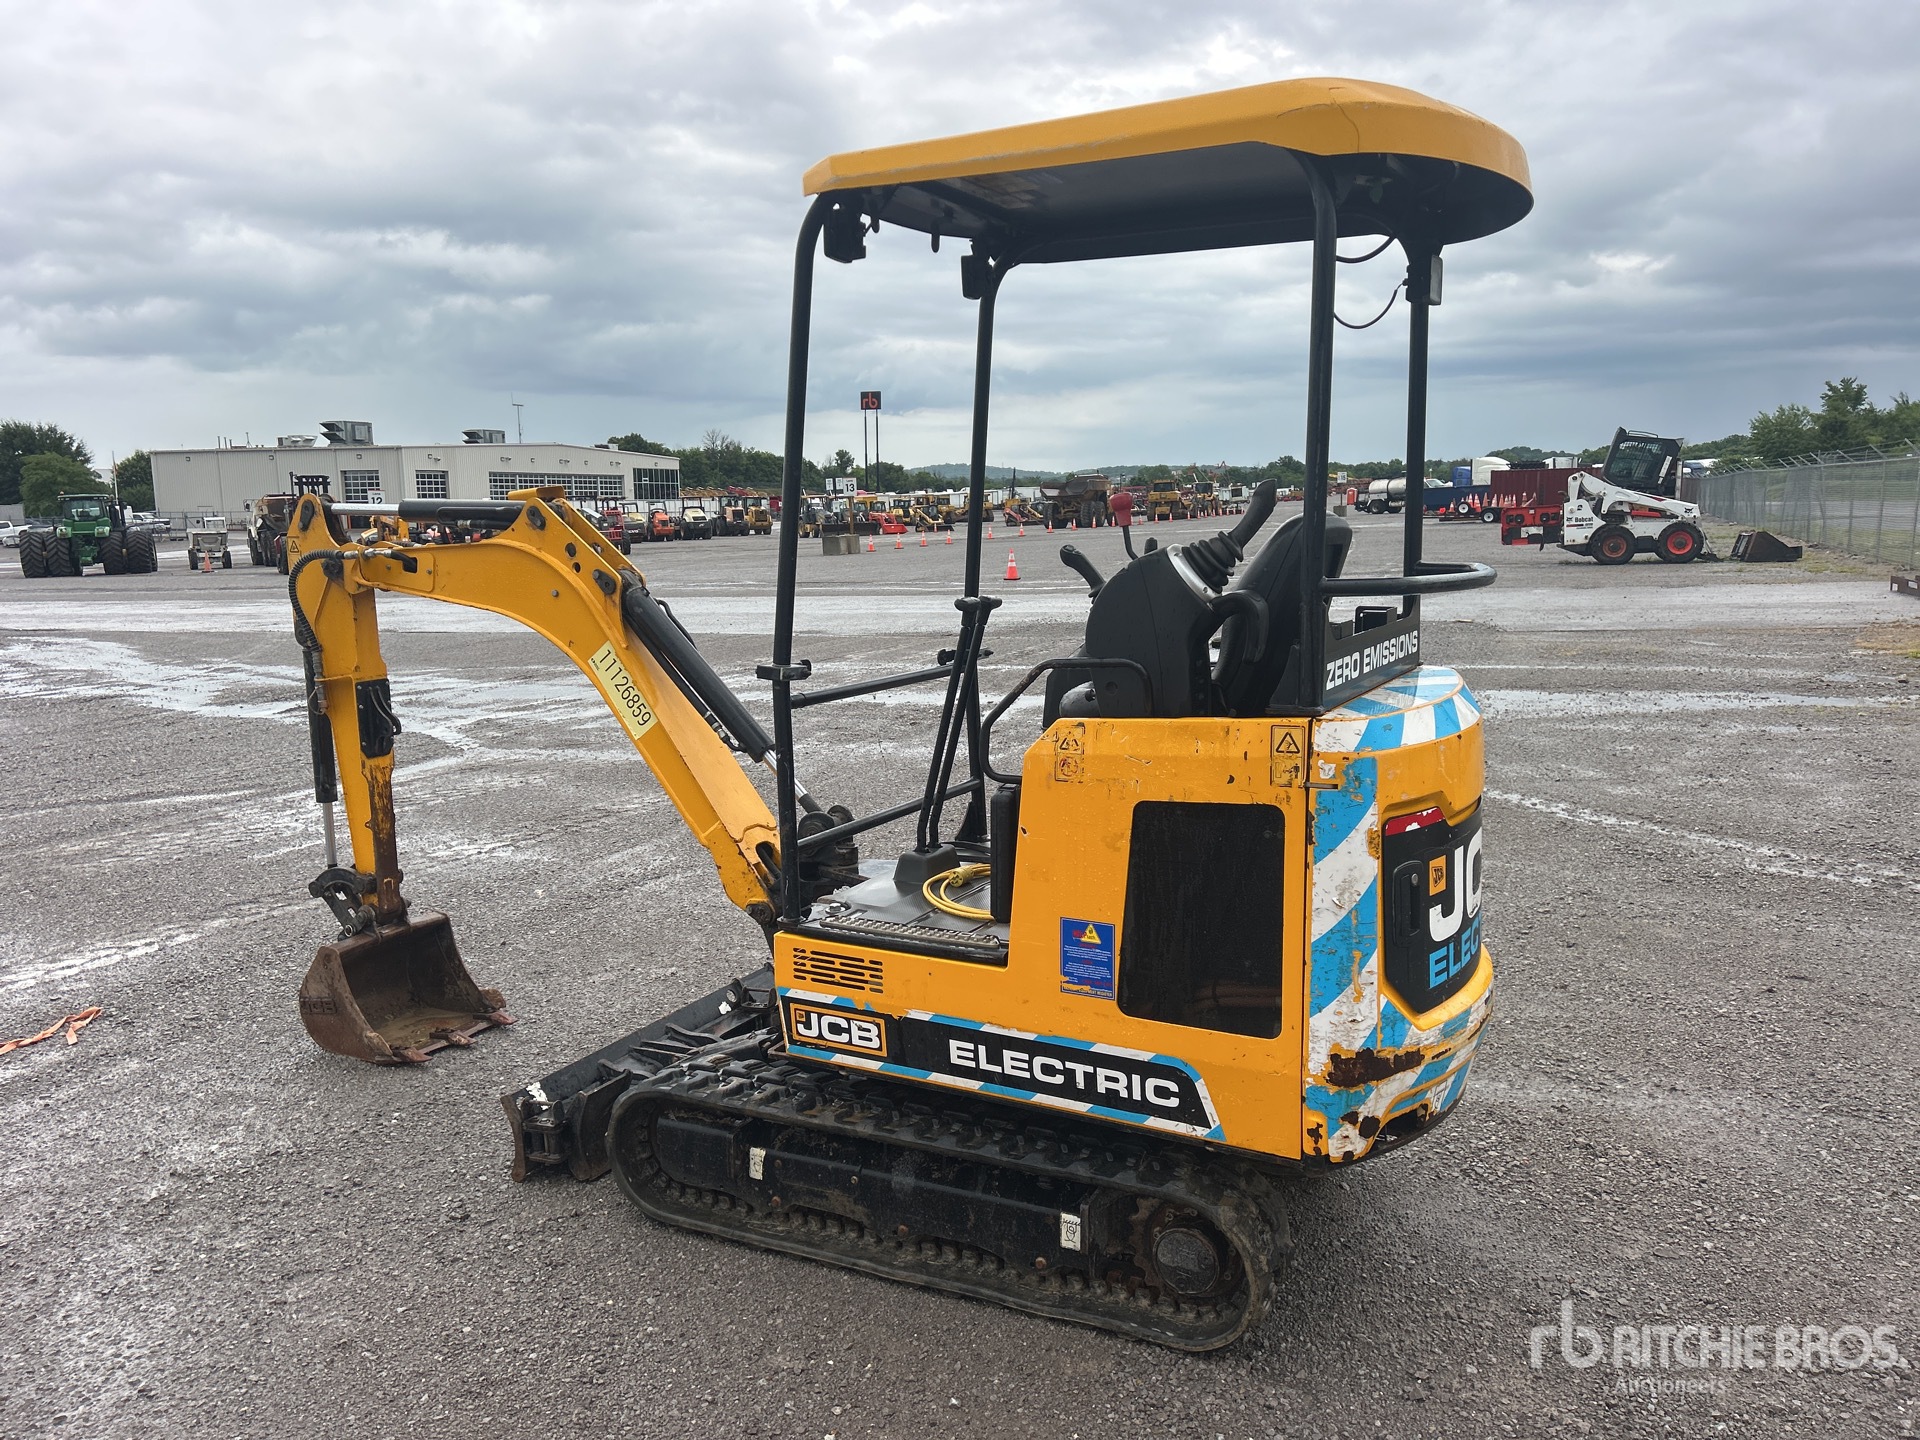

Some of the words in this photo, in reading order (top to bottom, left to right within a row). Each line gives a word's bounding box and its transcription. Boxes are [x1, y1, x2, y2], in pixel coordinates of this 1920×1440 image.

[863, 392, 878, 408] rb
[371, 496, 383, 504] 12
[845, 483, 855, 492] 13
[1325, 651, 1361, 691] ZERO
[1362, 630, 1418, 674] EMISSIONS
[599, 649, 652, 727] 11126859
[1433, 867, 1444, 885] JCB
[1429, 911, 1482, 990] ELEC
[796, 1012, 881, 1049] JCB
[949, 1038, 1180, 1108] ELECTRIC
